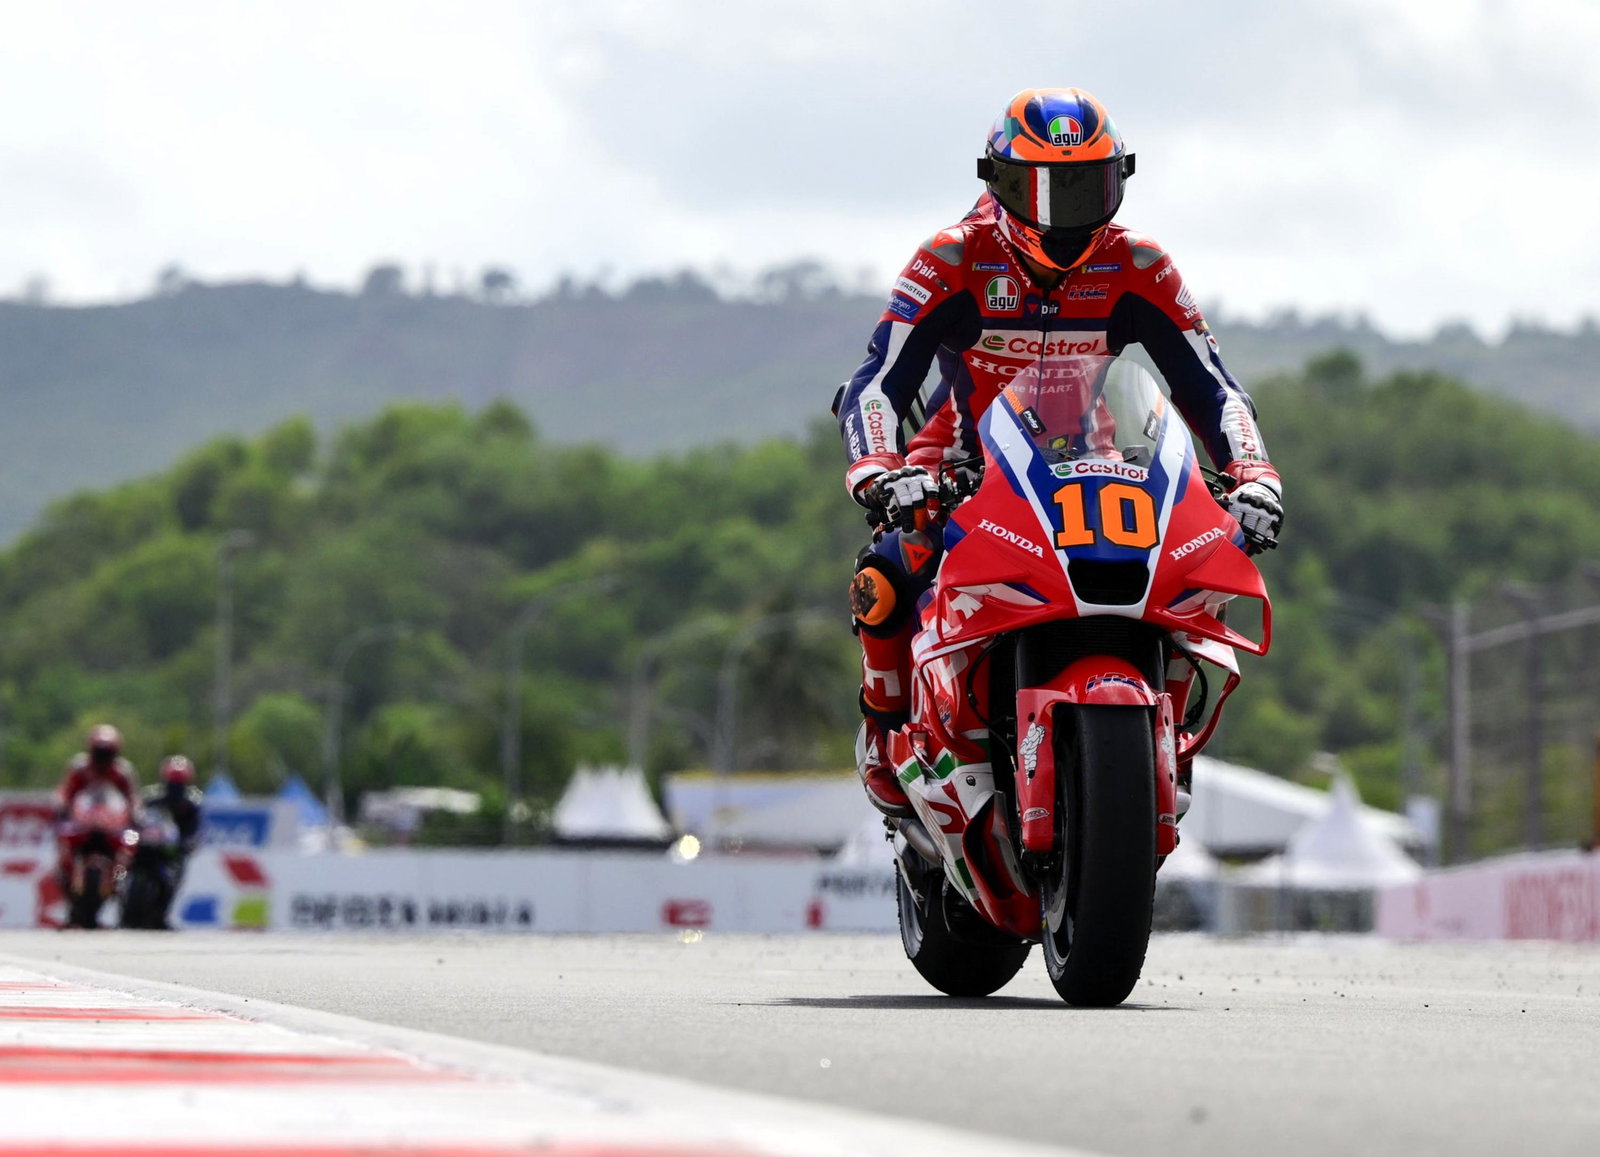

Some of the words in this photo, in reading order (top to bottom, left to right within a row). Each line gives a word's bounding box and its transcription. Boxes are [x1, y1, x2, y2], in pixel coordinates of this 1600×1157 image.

[1054, 133, 1080, 147] agv
[990, 296, 1015, 310] agv
[1008, 338, 1099, 356] Castrol
[969, 355, 1102, 380] HONDA
[867, 411, 887, 454] Castro
[1075, 461, 1145, 481] Castrol
[1053, 482, 1160, 550] 10
[978, 518, 1044, 559] HONDA
[1169, 526, 1226, 560] HONDA
